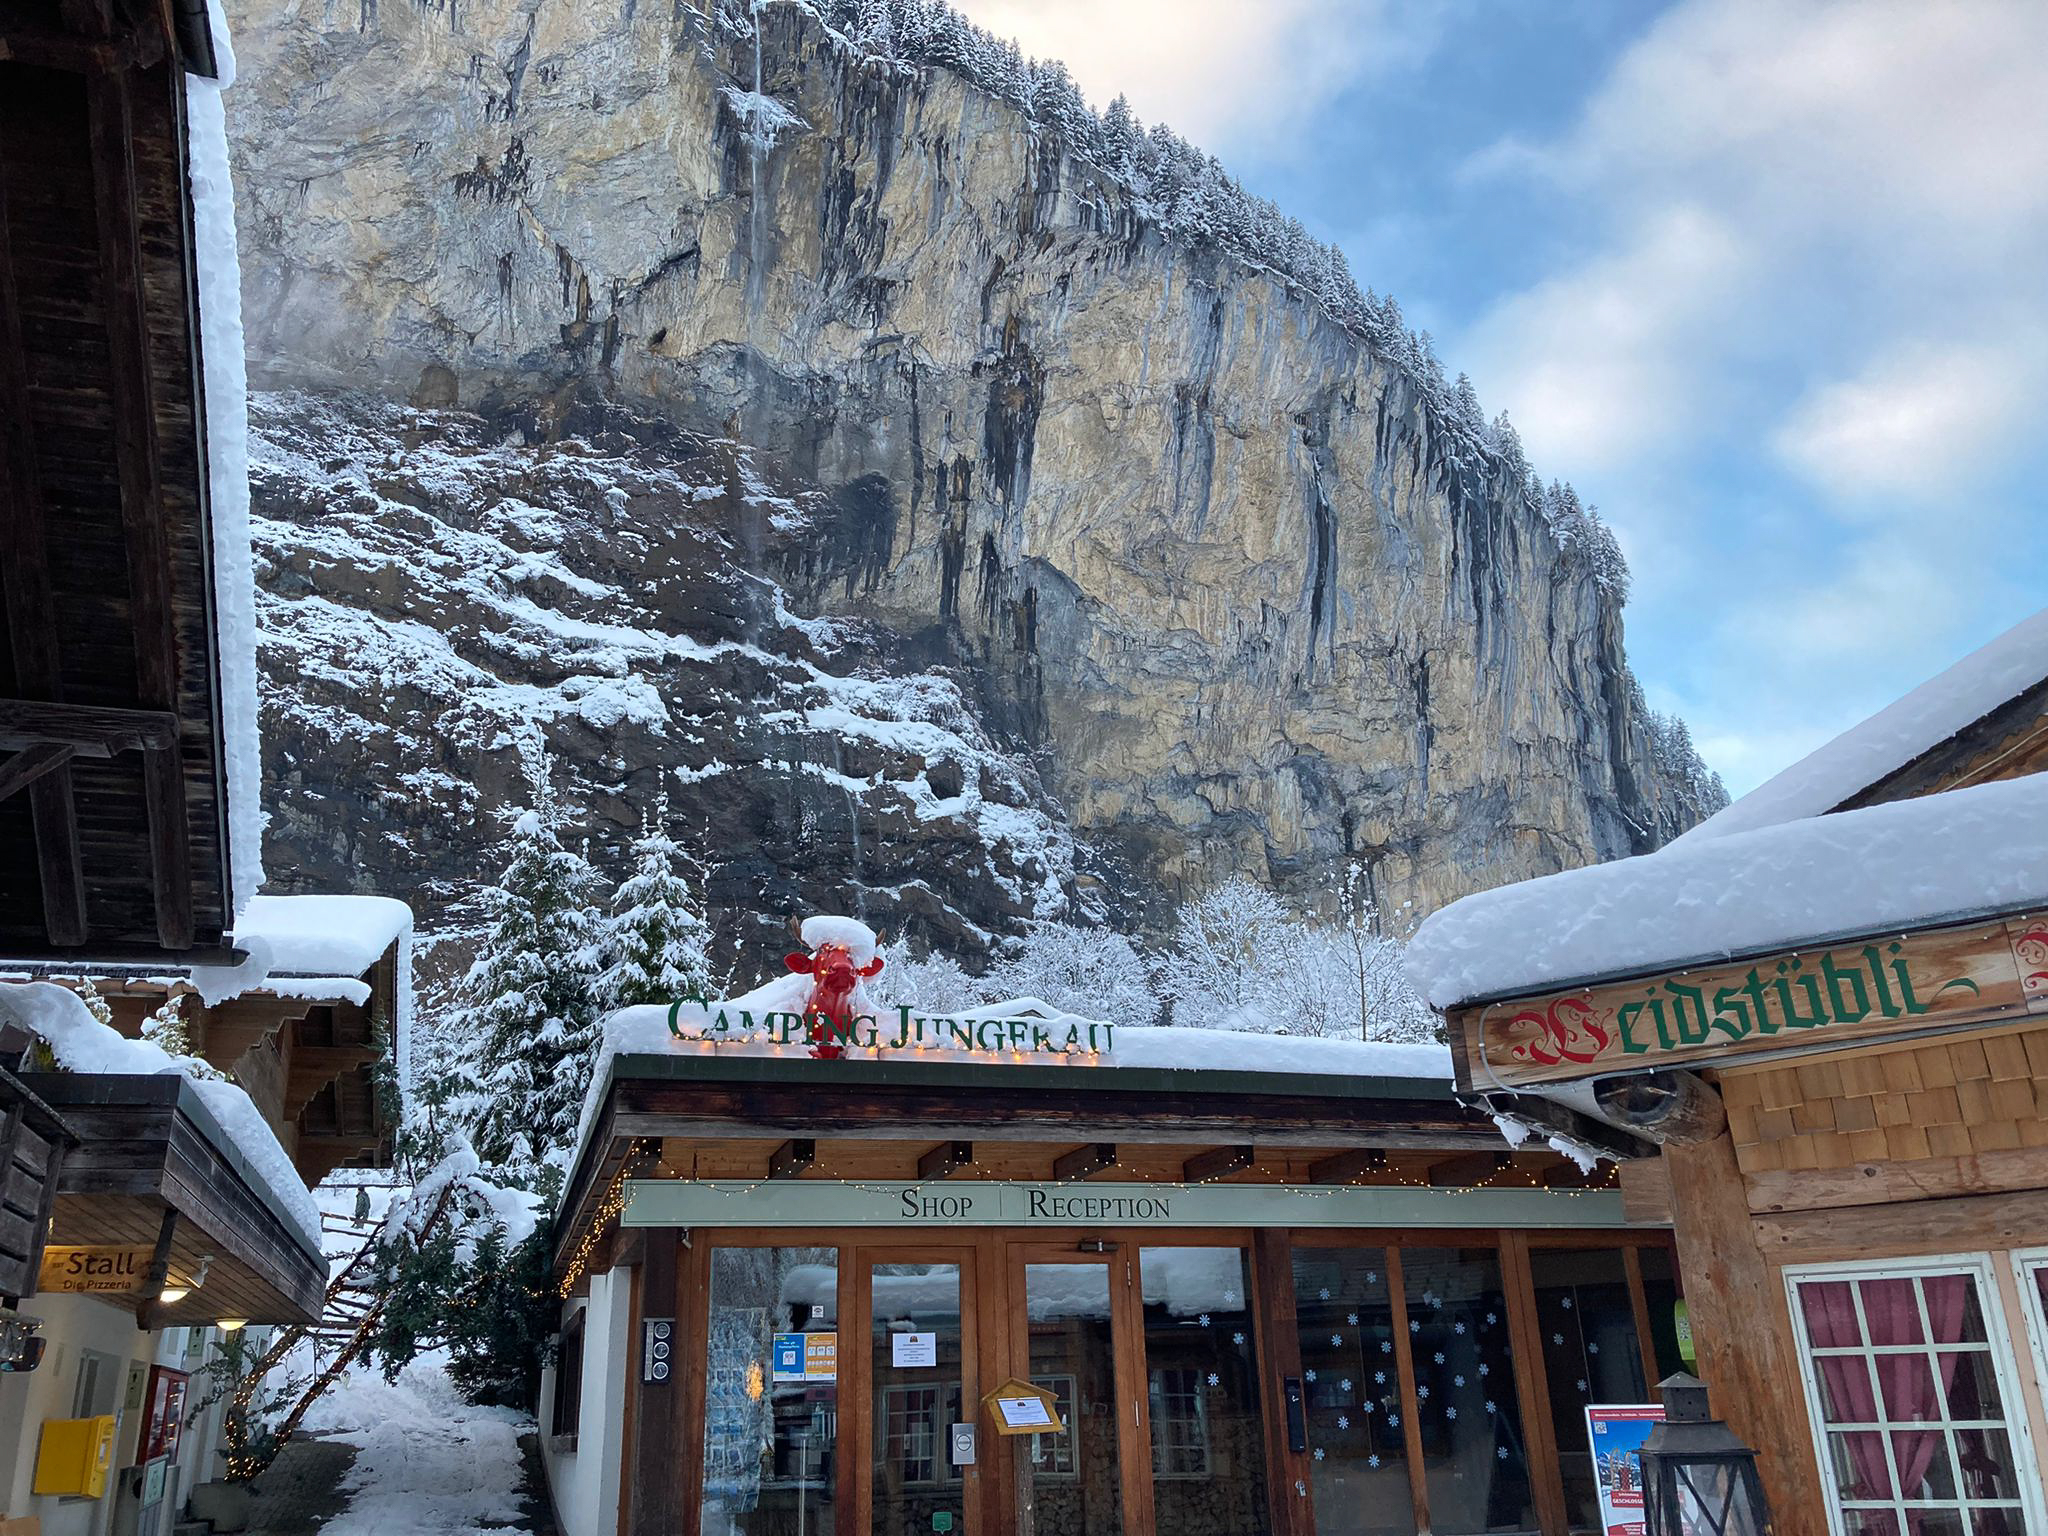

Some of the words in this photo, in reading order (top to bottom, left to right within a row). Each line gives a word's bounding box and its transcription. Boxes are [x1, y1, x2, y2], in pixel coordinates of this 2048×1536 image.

[901, 1188, 973, 1219] SHOP
[1027, 1189, 1171, 1219] RECEPTION
[66, 1252, 135, 1275] Stall
[63, 1279, 82, 1290] Die
[86, 1280, 132, 1290] Pizzeria
